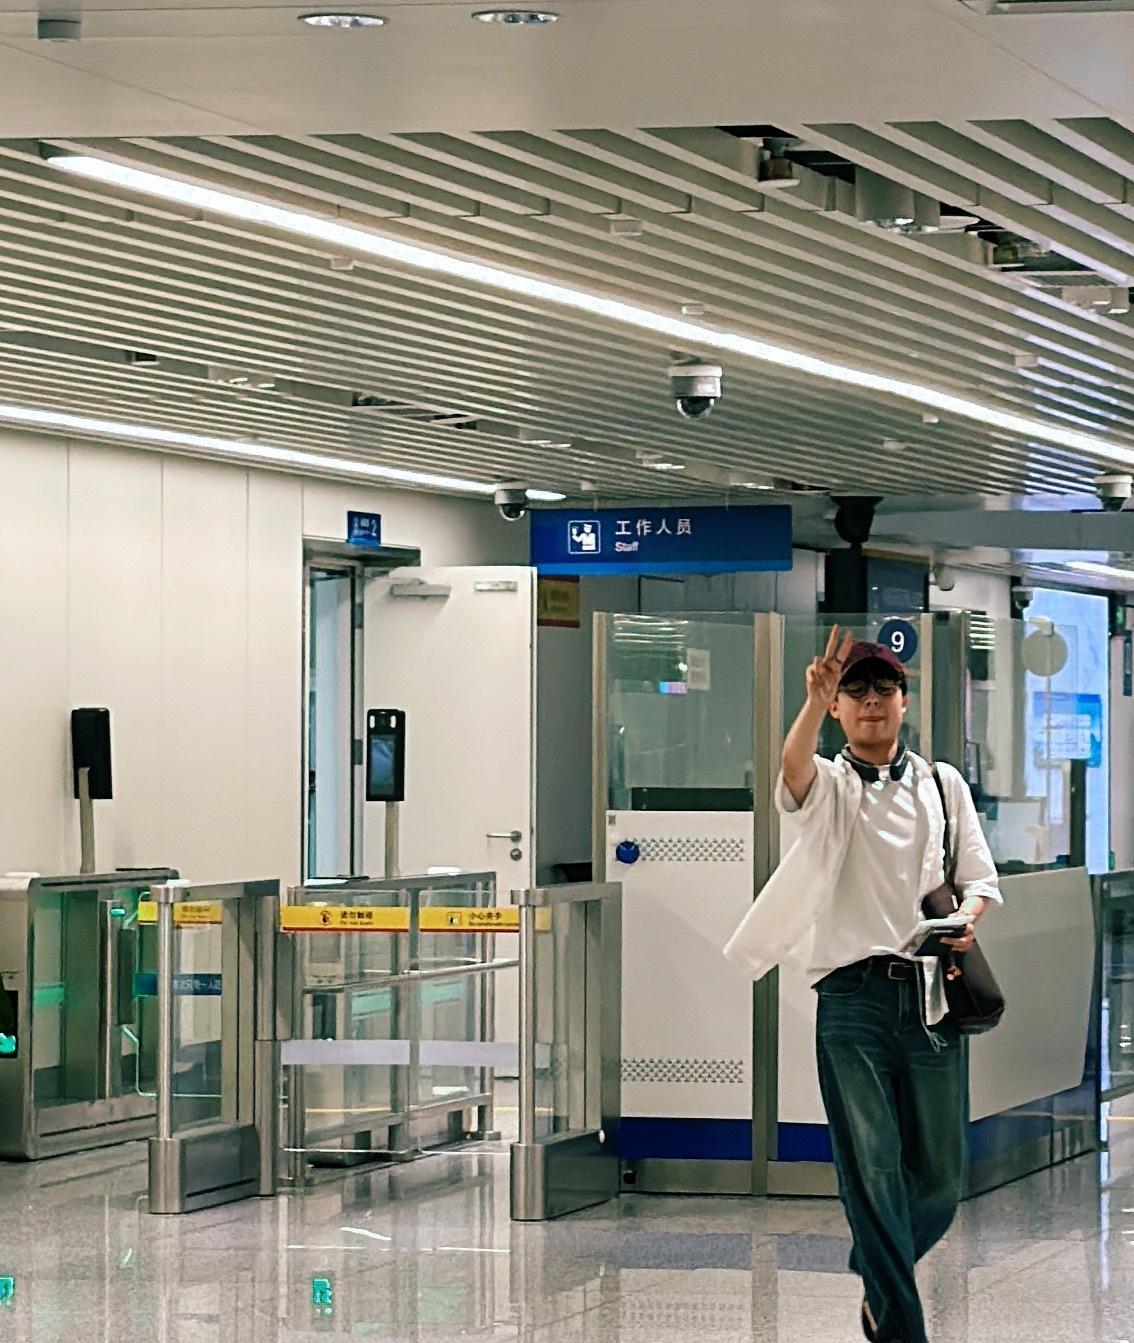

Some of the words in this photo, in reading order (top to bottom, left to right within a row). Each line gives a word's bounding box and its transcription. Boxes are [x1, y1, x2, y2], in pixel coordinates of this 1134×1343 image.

[615, 518, 693, 536] 工作人员
[615, 541, 639, 552] Staff
[891, 630, 905, 653] 9
